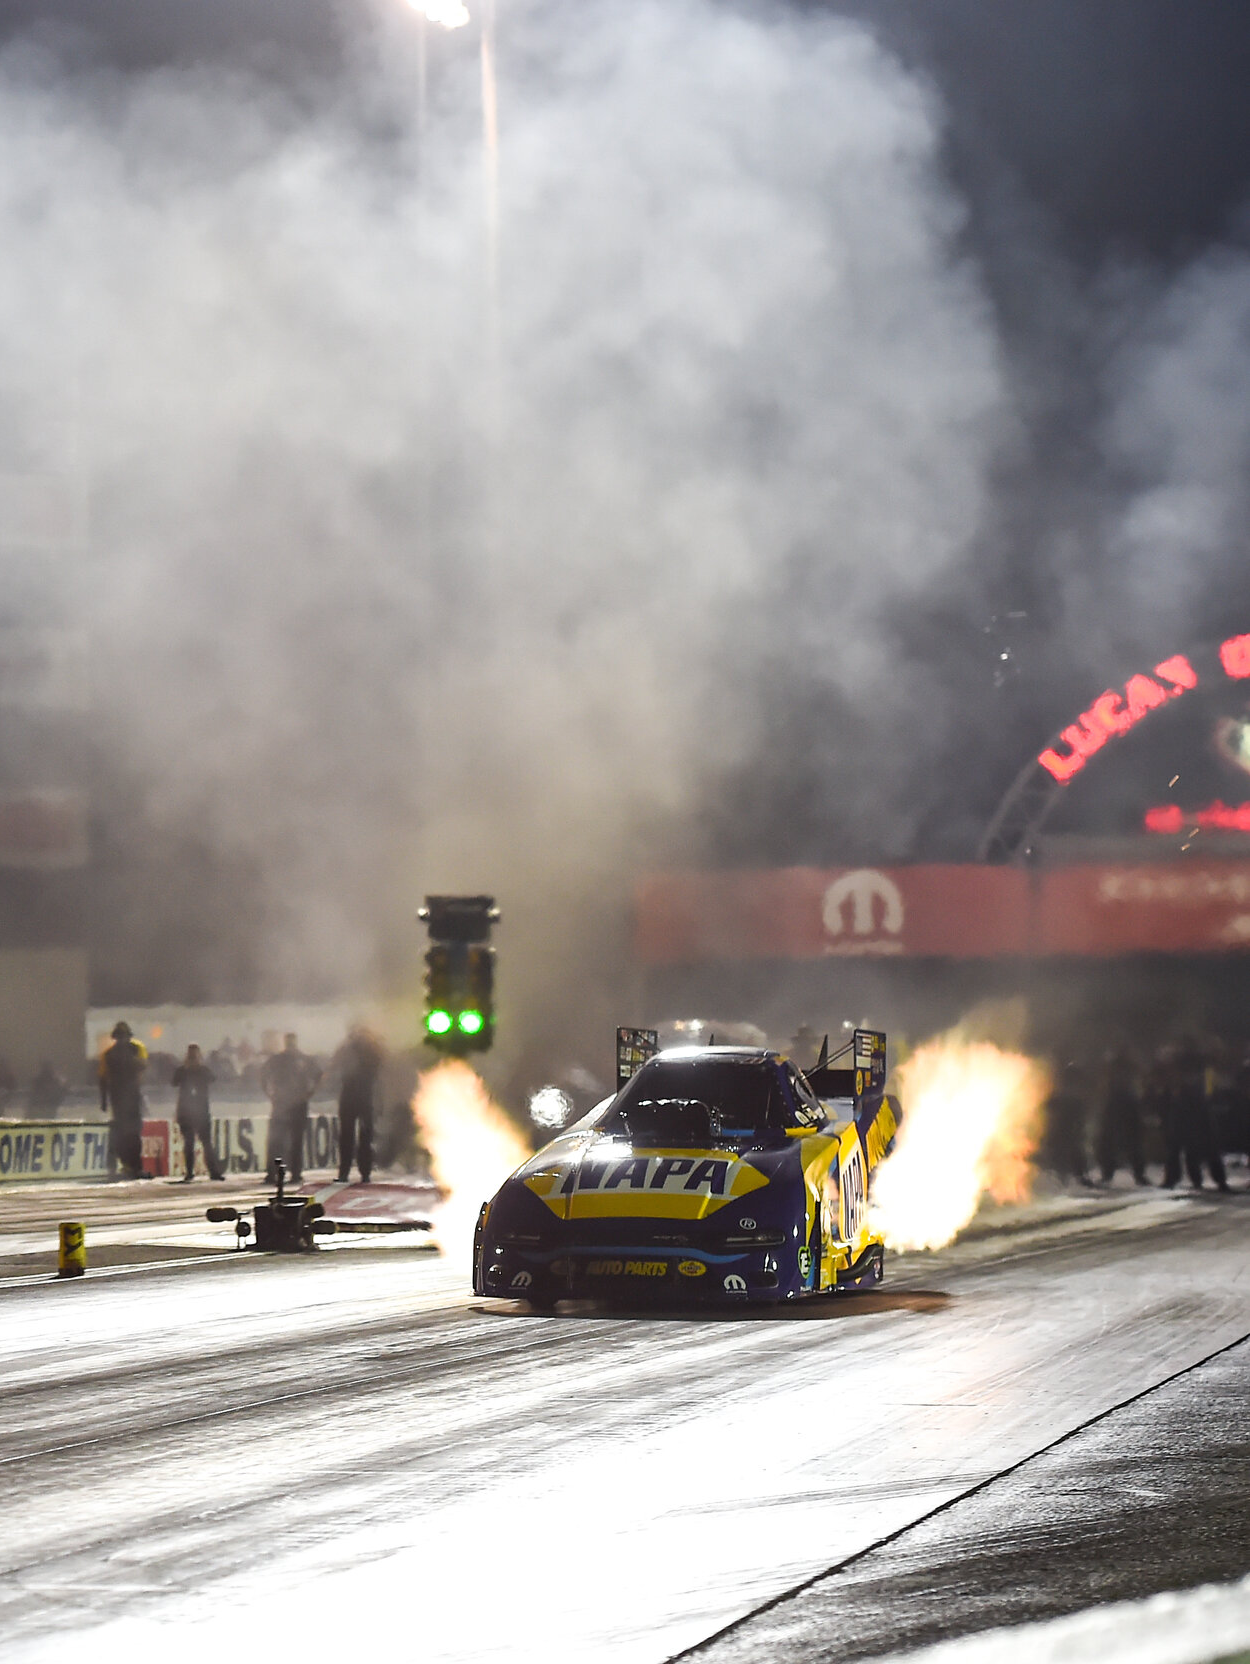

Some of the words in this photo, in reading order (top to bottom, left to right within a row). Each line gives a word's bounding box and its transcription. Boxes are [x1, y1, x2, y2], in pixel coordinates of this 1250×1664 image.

[1038, 655, 1197, 785] LUCAS
[51, 1132, 76, 1172] OF
[82, 1131, 109, 1171] TH
[560, 1158, 731, 1195] NAPA
[586, 1260, 623, 1276] AUTO
[624, 1260, 668, 1277] PARTS
